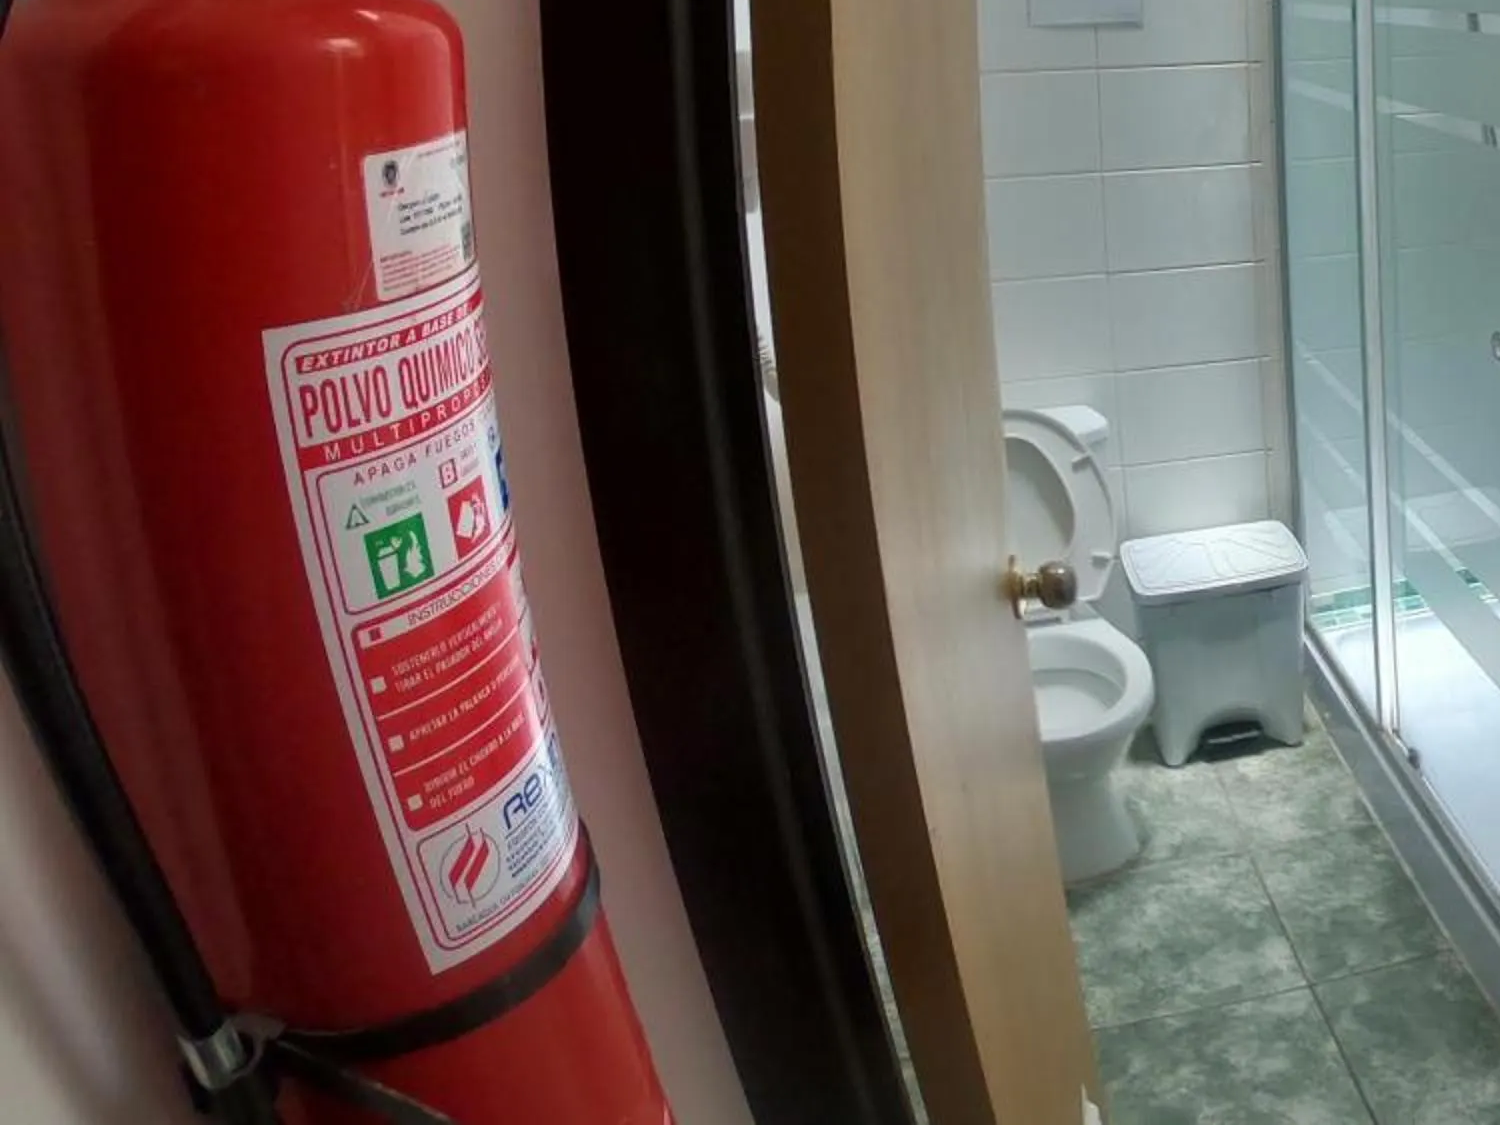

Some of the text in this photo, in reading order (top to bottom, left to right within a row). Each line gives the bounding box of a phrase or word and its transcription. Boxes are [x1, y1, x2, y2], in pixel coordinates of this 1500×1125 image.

[302, 335, 400, 372] EXTINTOR
[406, 329, 416, 343] A
[422, 310, 455, 337] BASE
[299, 365, 393, 439] POLVO
[399, 326, 475, 410] QUIMICO
[354, 452, 417, 486] APAGA
[425, 419, 476, 458] FUEGOS
